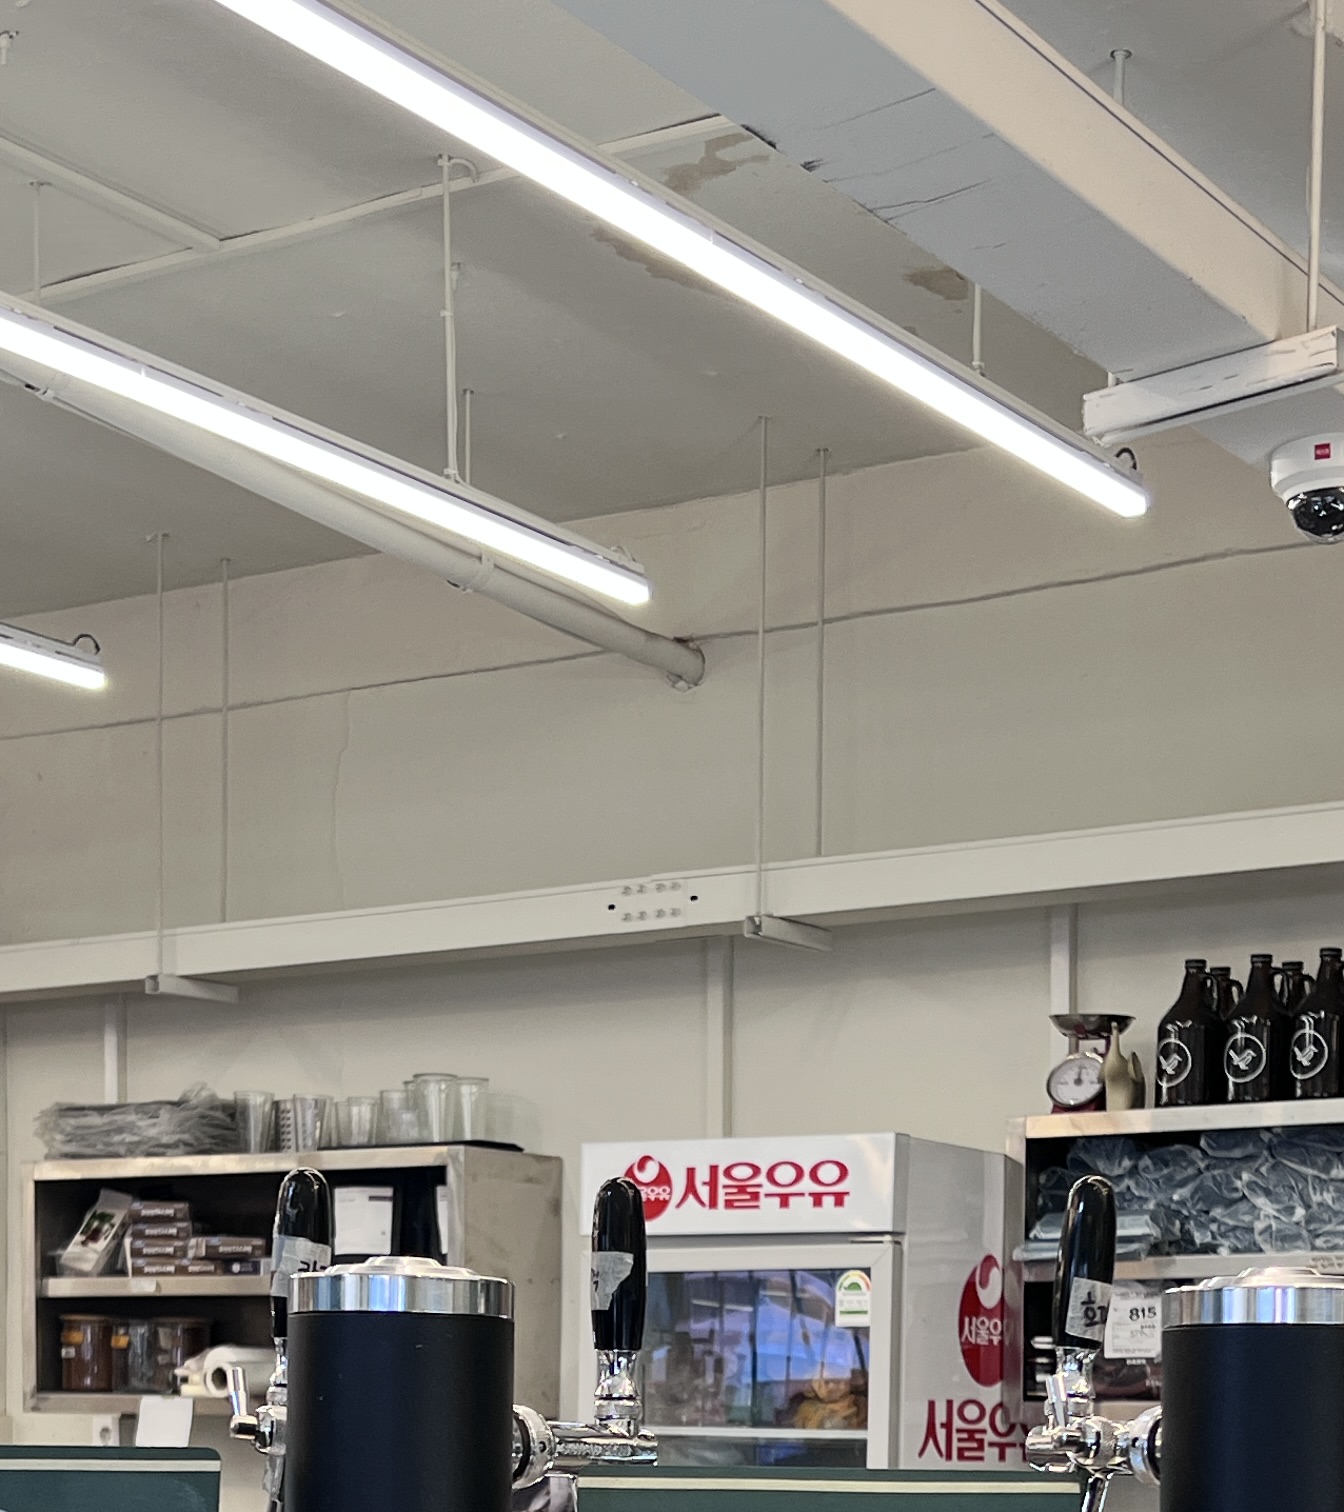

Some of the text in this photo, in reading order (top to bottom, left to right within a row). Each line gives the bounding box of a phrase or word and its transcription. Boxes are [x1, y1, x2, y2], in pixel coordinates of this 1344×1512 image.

[637, 1186, 671, 1202] 울우유
[675, 1159, 850, 1210] 서울우유
[961, 1315, 1004, 1346] 서울우
